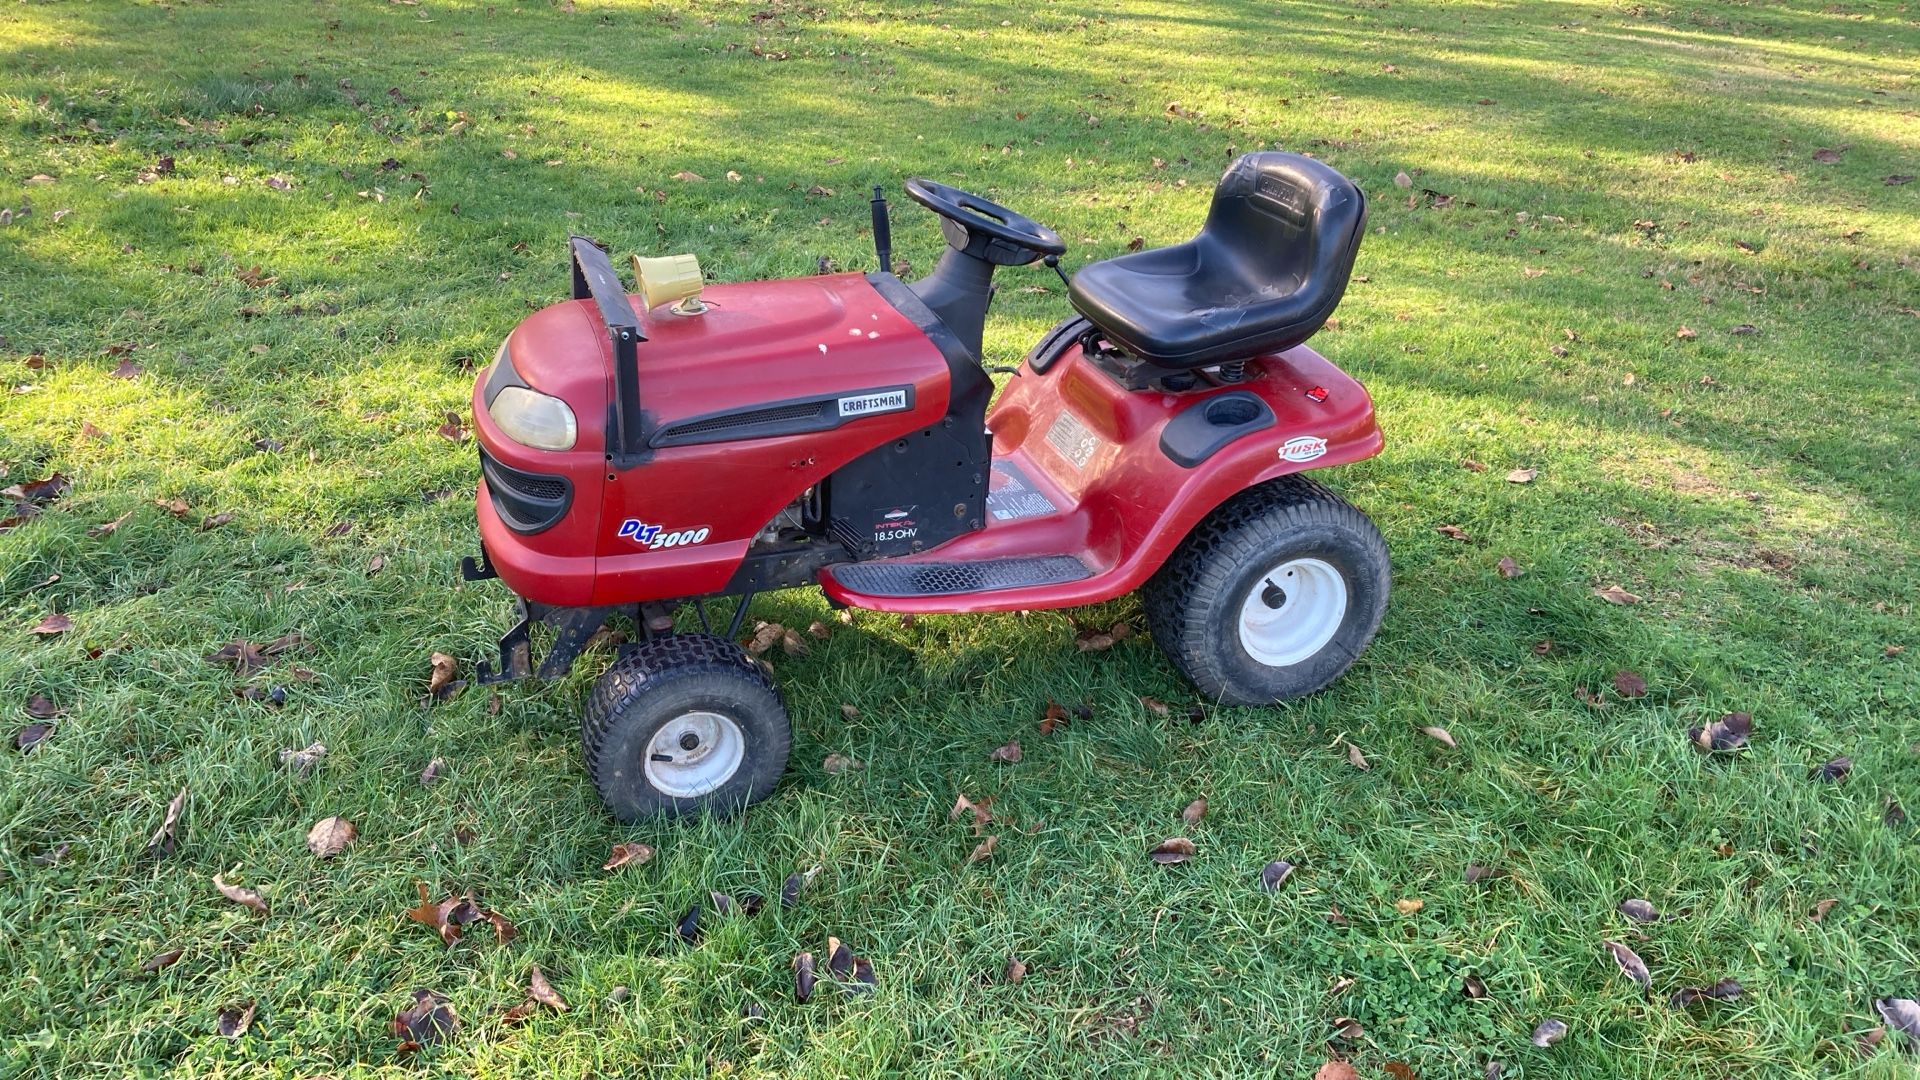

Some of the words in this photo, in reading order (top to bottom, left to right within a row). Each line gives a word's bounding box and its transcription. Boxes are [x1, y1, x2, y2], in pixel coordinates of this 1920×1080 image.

[843, 395, 902, 412] CRAFTSMAN
[1281, 441, 1325, 456] TUSK
[618, 519, 662, 544] DLT
[649, 528, 709, 549] 3000
[875, 530, 894, 541] 18.5
[895, 528, 918, 539] OHV
